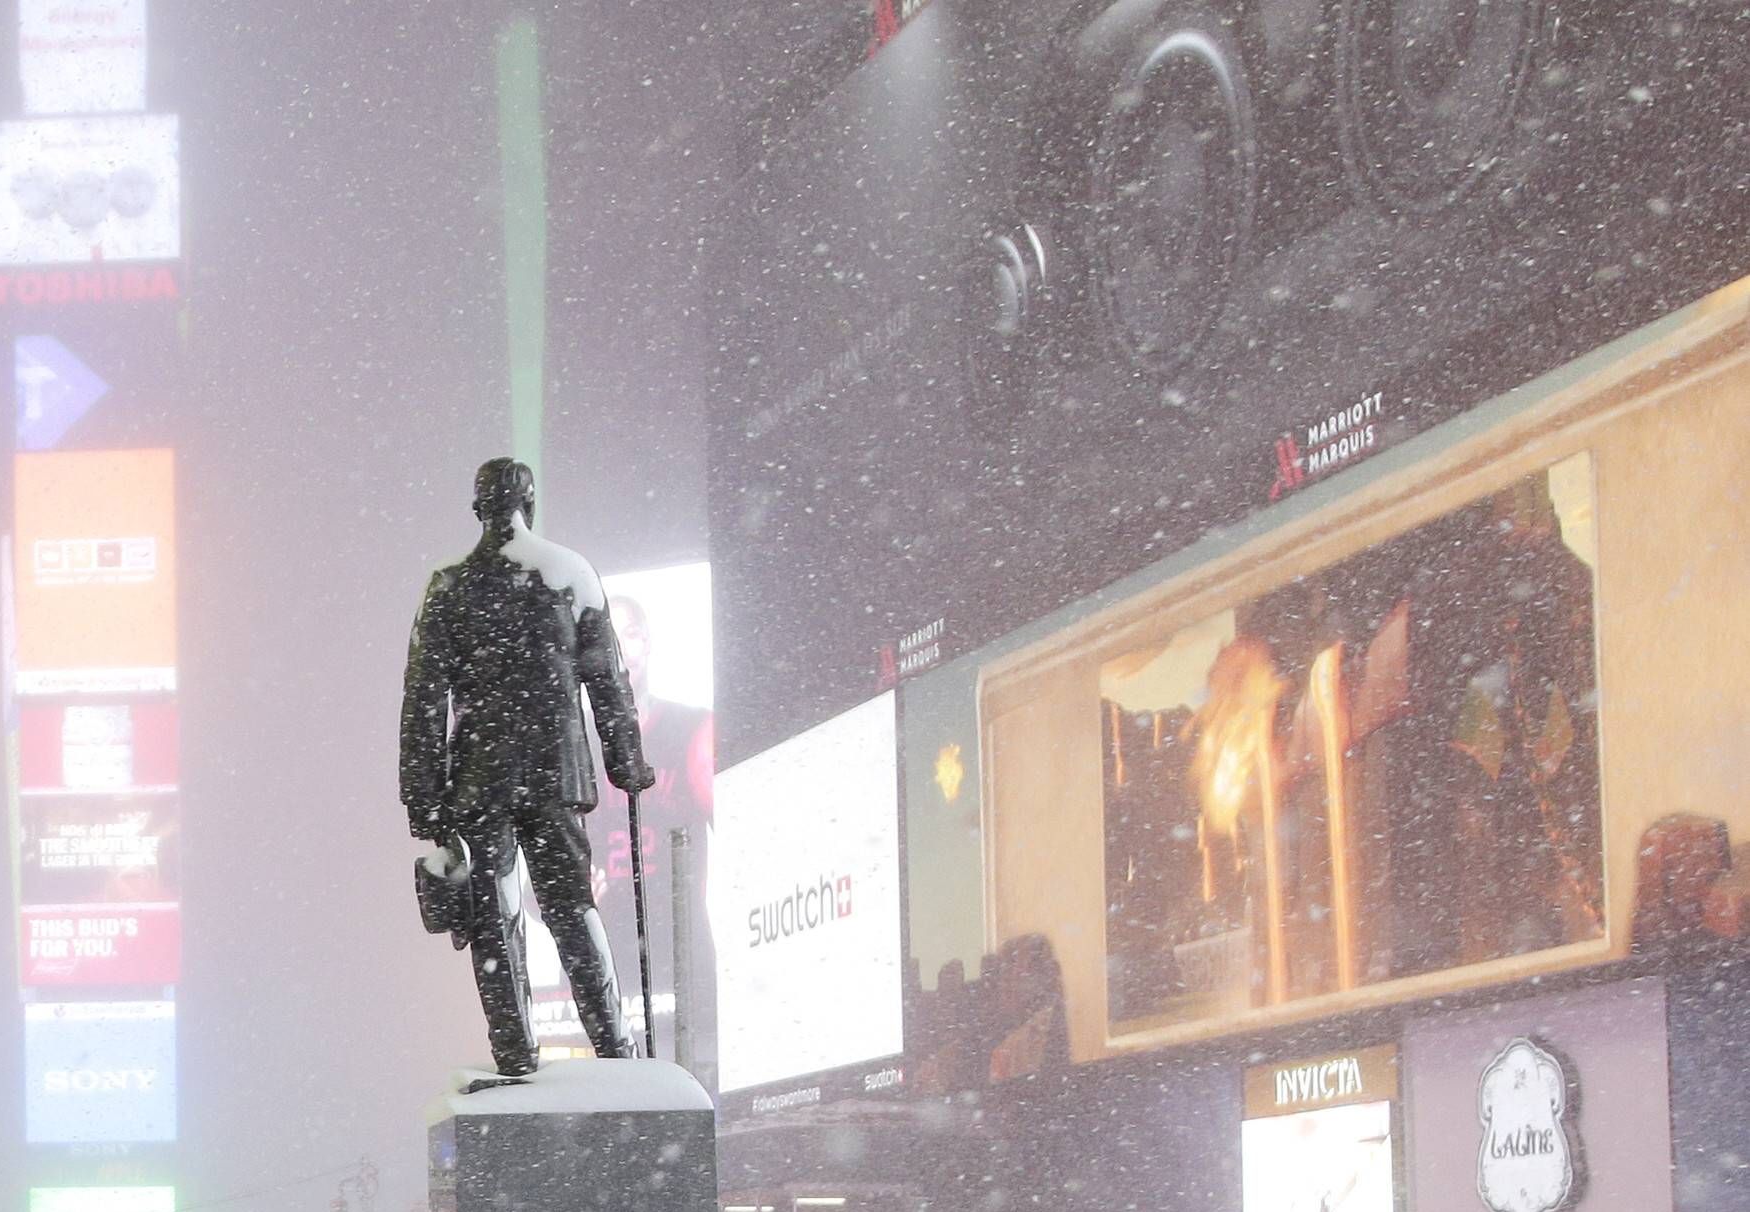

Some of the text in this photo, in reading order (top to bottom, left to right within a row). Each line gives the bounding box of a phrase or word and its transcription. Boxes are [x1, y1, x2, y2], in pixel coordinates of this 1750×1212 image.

[1307, 391, 1383, 447] MARRIOTT
[1308, 424, 1375, 473] MARQUIS
[899, 617, 945, 653] MARRIOTT
[900, 642, 940, 673] MARQUIS
[29, 917, 138, 938] THIS BUD'S
[748, 873, 836, 949] swatch
[30, 937, 118, 958] FOR YOU.
[44, 1069, 157, 1091] SONY
[1274, 1057, 1363, 1105] INVICTA
